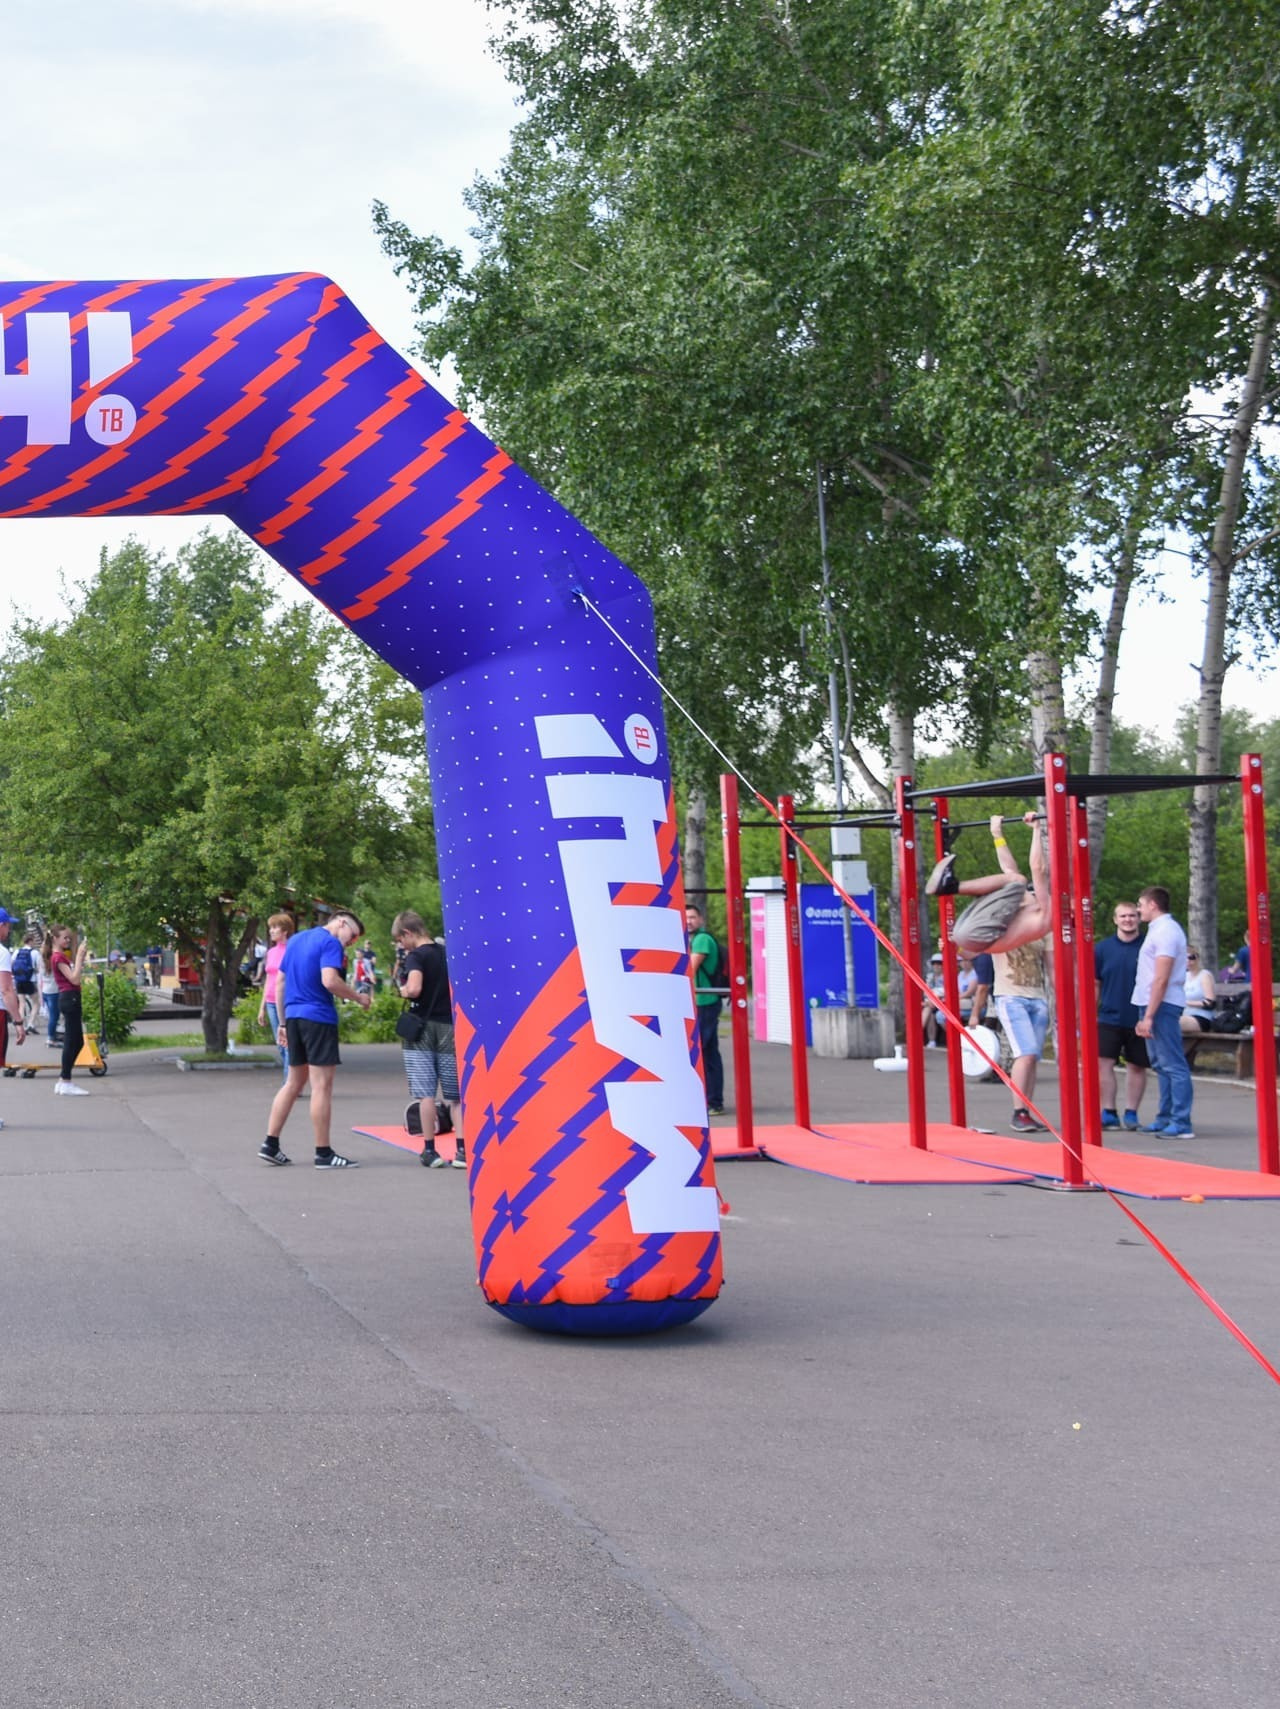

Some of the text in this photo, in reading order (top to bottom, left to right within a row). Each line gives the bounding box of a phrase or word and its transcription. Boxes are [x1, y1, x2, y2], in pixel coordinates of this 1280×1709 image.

[98, 408, 123, 432] ТВ
[633, 726, 652, 750] ТВ
[534, 713, 721, 1234] МАТЧ!
